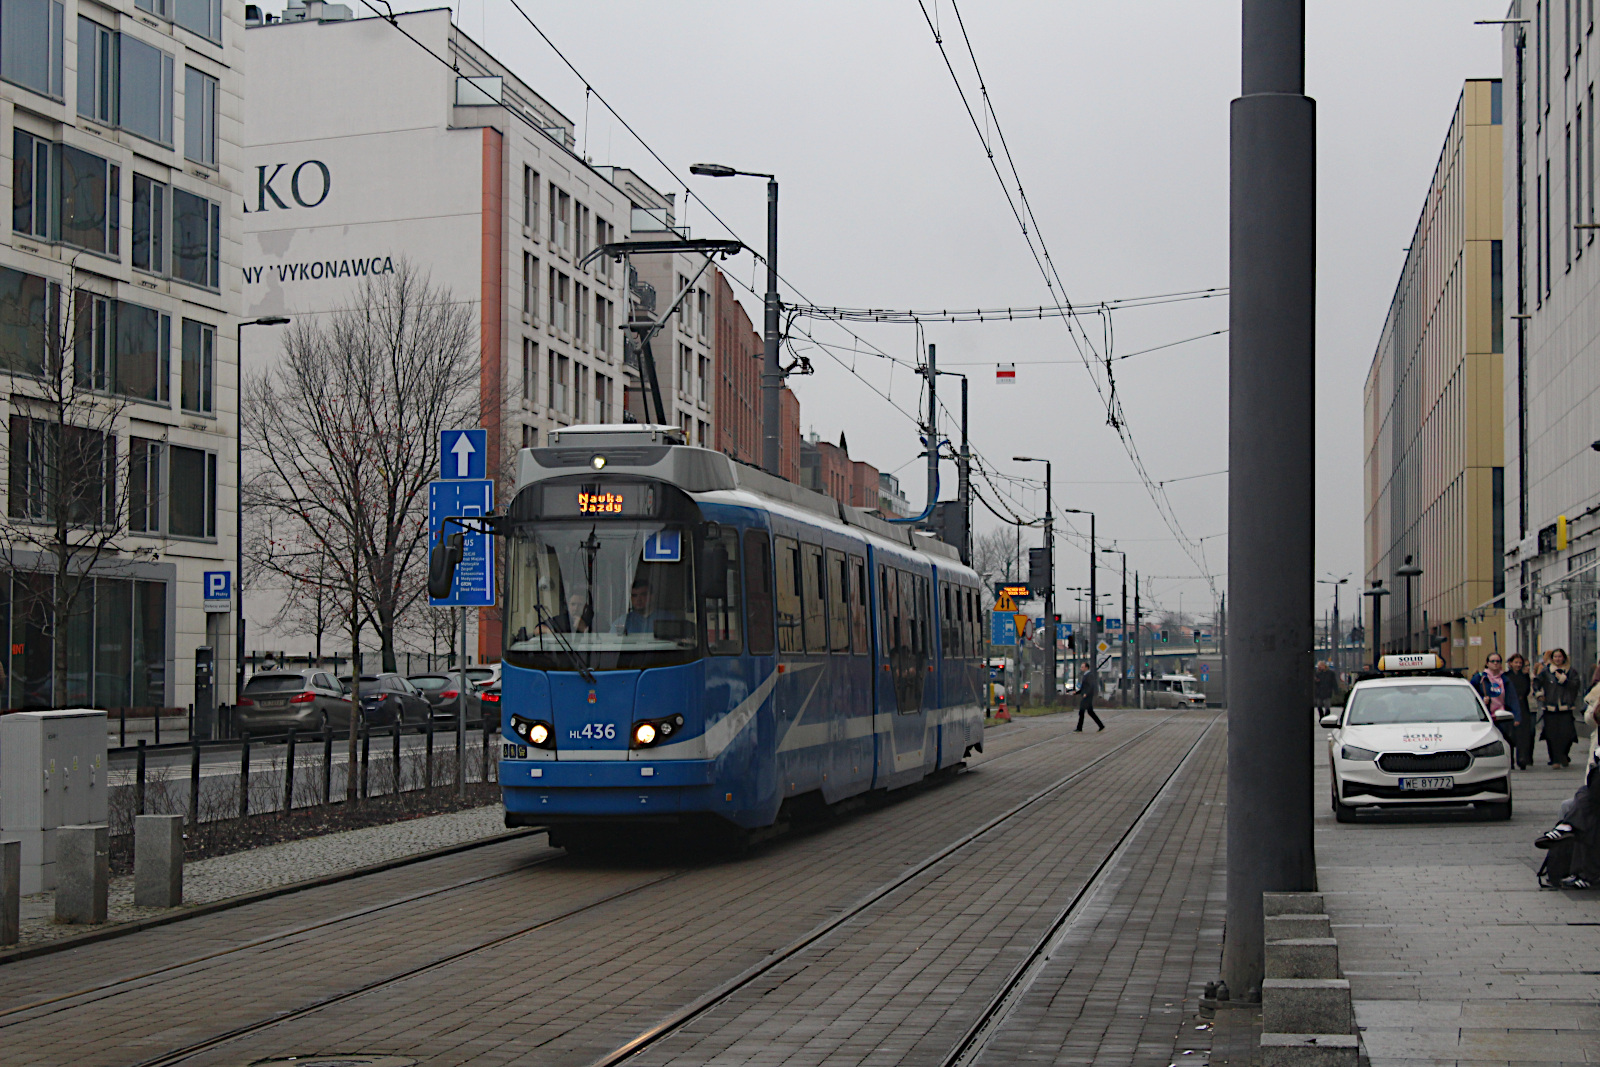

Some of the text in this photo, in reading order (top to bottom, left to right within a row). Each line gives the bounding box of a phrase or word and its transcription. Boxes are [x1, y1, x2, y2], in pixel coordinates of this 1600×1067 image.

[578, 492, 624, 504] Nauka
[579, 503, 623, 513] Jazdy
[655, 531, 672, 555] L
[209, 574, 226, 597] P
[1405, 779, 1418, 789] WE
